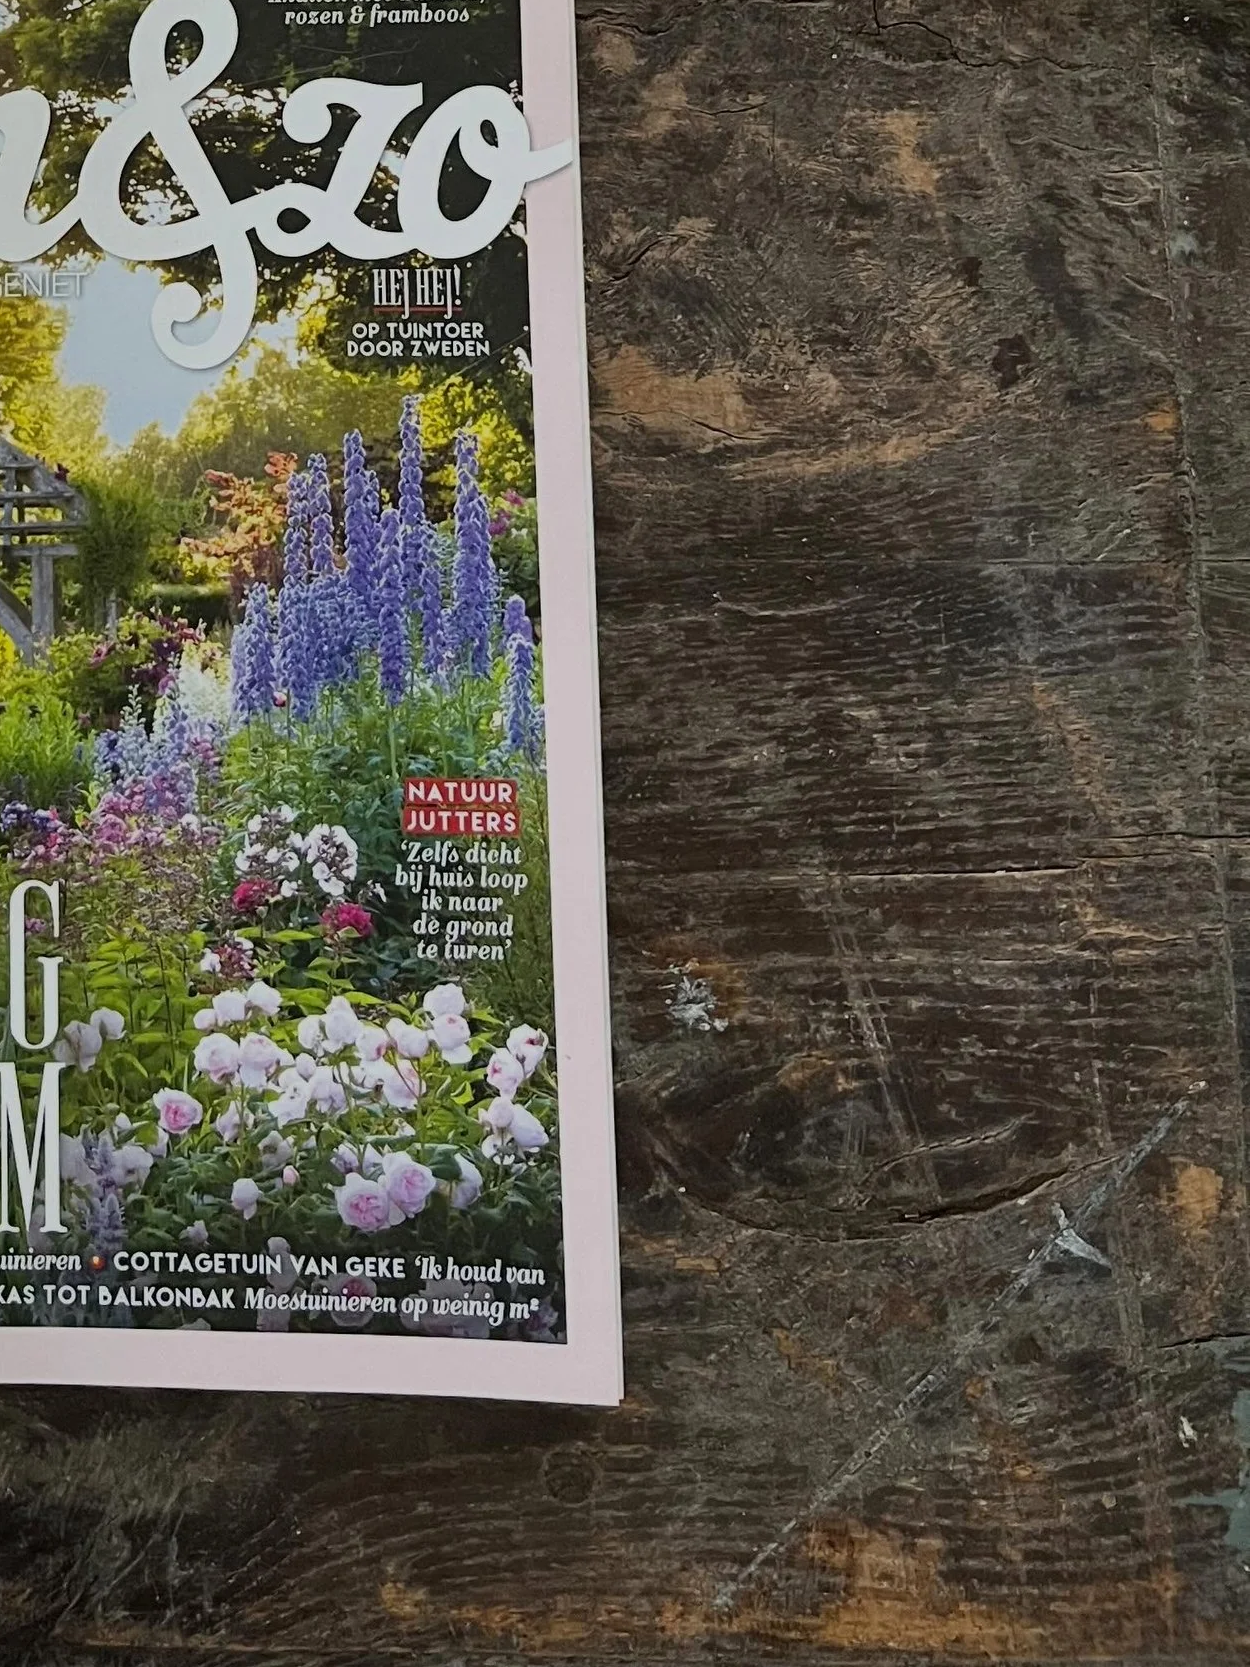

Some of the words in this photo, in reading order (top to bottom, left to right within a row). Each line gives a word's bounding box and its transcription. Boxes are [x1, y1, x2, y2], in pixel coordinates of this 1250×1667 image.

[285, 8, 344, 24] rozen
[350, 5, 365, 23] &
[370, 3, 470, 26] framboos
[372, 268, 409, 318] HEJ
[415, 263, 461, 318] HEJ!
[352, 321, 380, 338] OP
[386, 321, 484, 338] TUINTOER
[346, 339, 403, 356] DOOR
[410, 339, 490, 356] ZWEDEN
[408, 781, 512, 802] NATUUR
[407, 809, 516, 831] JUTTERS
[465, 842, 522, 863] dicht
[395, 864, 423, 892] bij
[429, 864, 474, 887] huis
[480, 865, 528, 894] loop
[421, 889, 442, 910] ik
[449, 895, 503, 911] naar
[445, 913, 513, 941] grond
[417, 939, 438, 958] te
[113, 1251, 283, 1274] COTTAGETUIN
[290, 1254, 338, 1275] VAN
[345, 1255, 406, 1278] GEKE
[447, 1258, 502, 1283] houd
[505, 1264, 545, 1284] van
[44, 1283, 91, 1304] TOT
[98, 1284, 235, 1308] BALKONBAK
[243, 1286, 397, 1312] Moestuinieren
[400, 1293, 428, 1318] op
[432, 1293, 505, 1324] weinig
